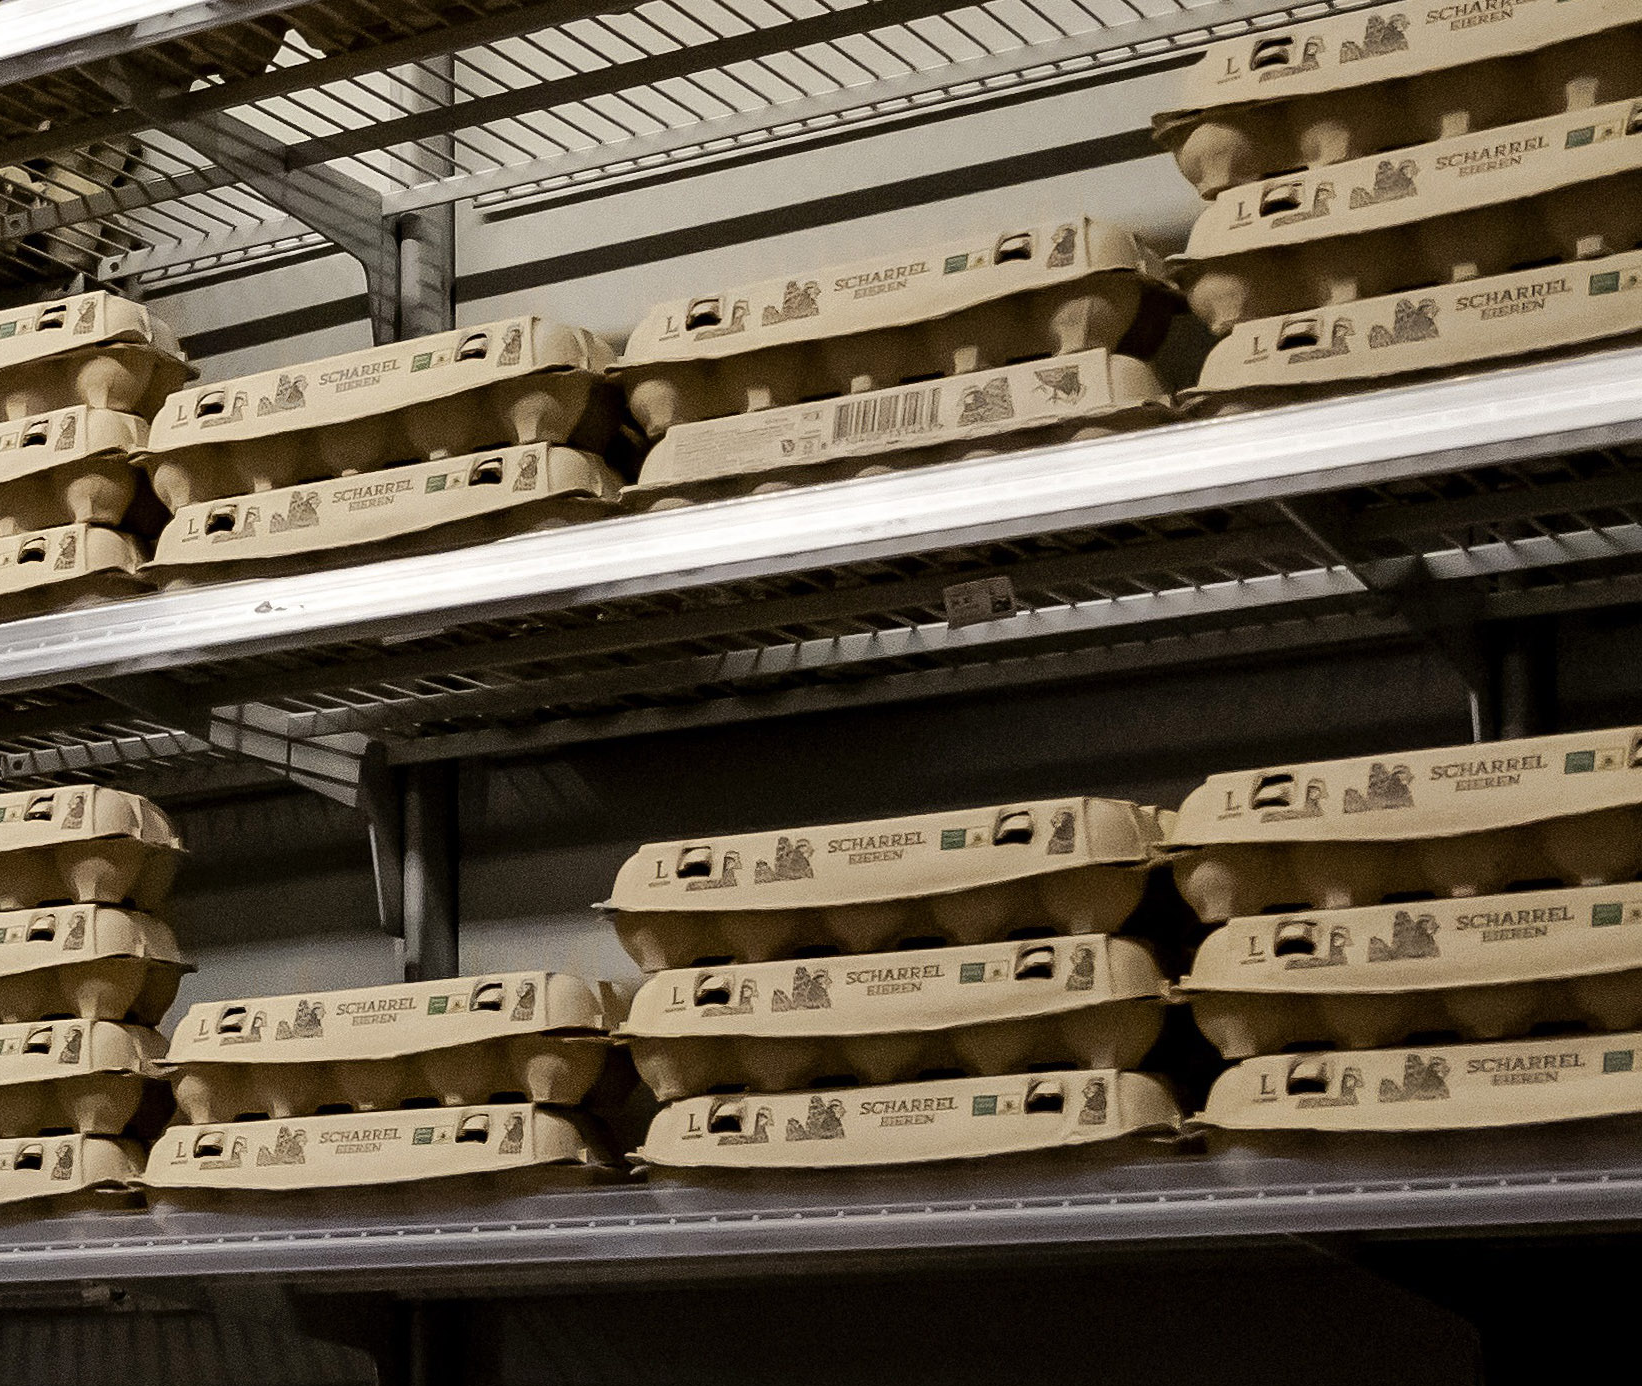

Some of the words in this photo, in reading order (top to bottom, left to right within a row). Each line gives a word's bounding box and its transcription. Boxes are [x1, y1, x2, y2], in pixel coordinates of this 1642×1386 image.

[1226, 58, 1239, 75] L
[1435, 135, 1549, 170] SCHARREL
[1237, 202, 1251, 220] L
[833, 261, 930, 293] SCHARREL
[1455, 278, 1572, 311] SCHARREL
[666, 316, 677, 335] L
[1252, 337, 1263, 355] L
[319, 358, 401, 387] SCHARREL
[177, 406, 188, 423] L
[332, 480, 414, 505] SCHARREL
[189, 519, 199, 536] L
[1430, 755, 1548, 781] SCHARREL
[1225, 791, 1239, 811] L
[828, 833, 926, 853] SCHARREL
[655, 861, 667, 879] L
[1457, 906, 1574, 930] SCHARREL
[1249, 937, 1263, 956] L
[846, 965, 944, 985] SCHARREL
[672, 988, 683, 1006] L
[336, 998, 417, 1016] SCHARREL
[199, 1021, 209, 1036] L
[1467, 1054, 1585, 1074] SCHARREL
[1261, 1075, 1275, 1095] L
[859, 1098, 958, 1117] SCHARREL
[688, 1114, 700, 1132] L
[319, 1129, 402, 1144] SCHARREL
[175, 1141, 185, 1157] L
